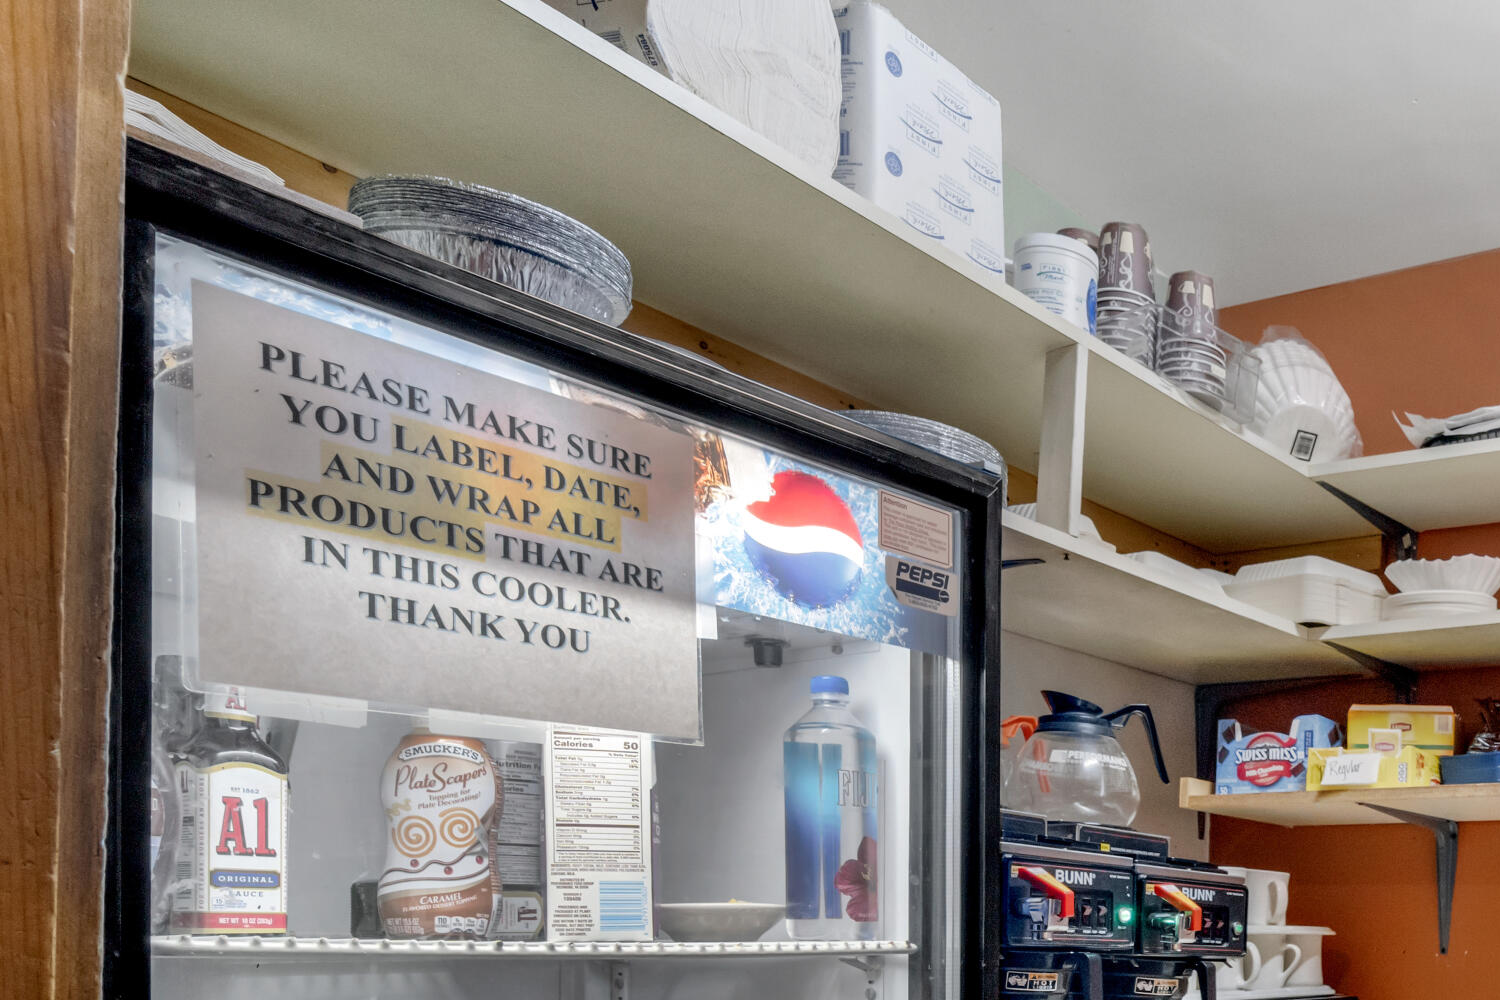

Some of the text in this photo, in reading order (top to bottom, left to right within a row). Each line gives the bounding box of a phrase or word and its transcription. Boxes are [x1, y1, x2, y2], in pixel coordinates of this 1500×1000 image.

[258, 341, 652, 479] PLEASE MAKE SURE
[280, 394, 641, 517] YOU LABEL, DATE,
[322, 453, 615, 545] AND WRAP ALL
[248, 478, 664, 592] PRODUCTS THAT ARE
[301, 535, 631, 623] IN THIS COOLER.
[896, 561, 949, 590] PEPSI
[358, 591, 591, 653] THANK YOU
[404, 744, 480, 761] SMUCKER'S
[553, 740, 638, 750] Calories 50
[1329, 760, 1362, 781] Regular
[215, 796, 277, 857] A1
[218, 875, 274, 884] ORIGINAL
[1055, 869, 1093, 886] BUNN
[420, 892, 462, 904] CARAMEL
[1182, 887, 1212, 901] BUNN
